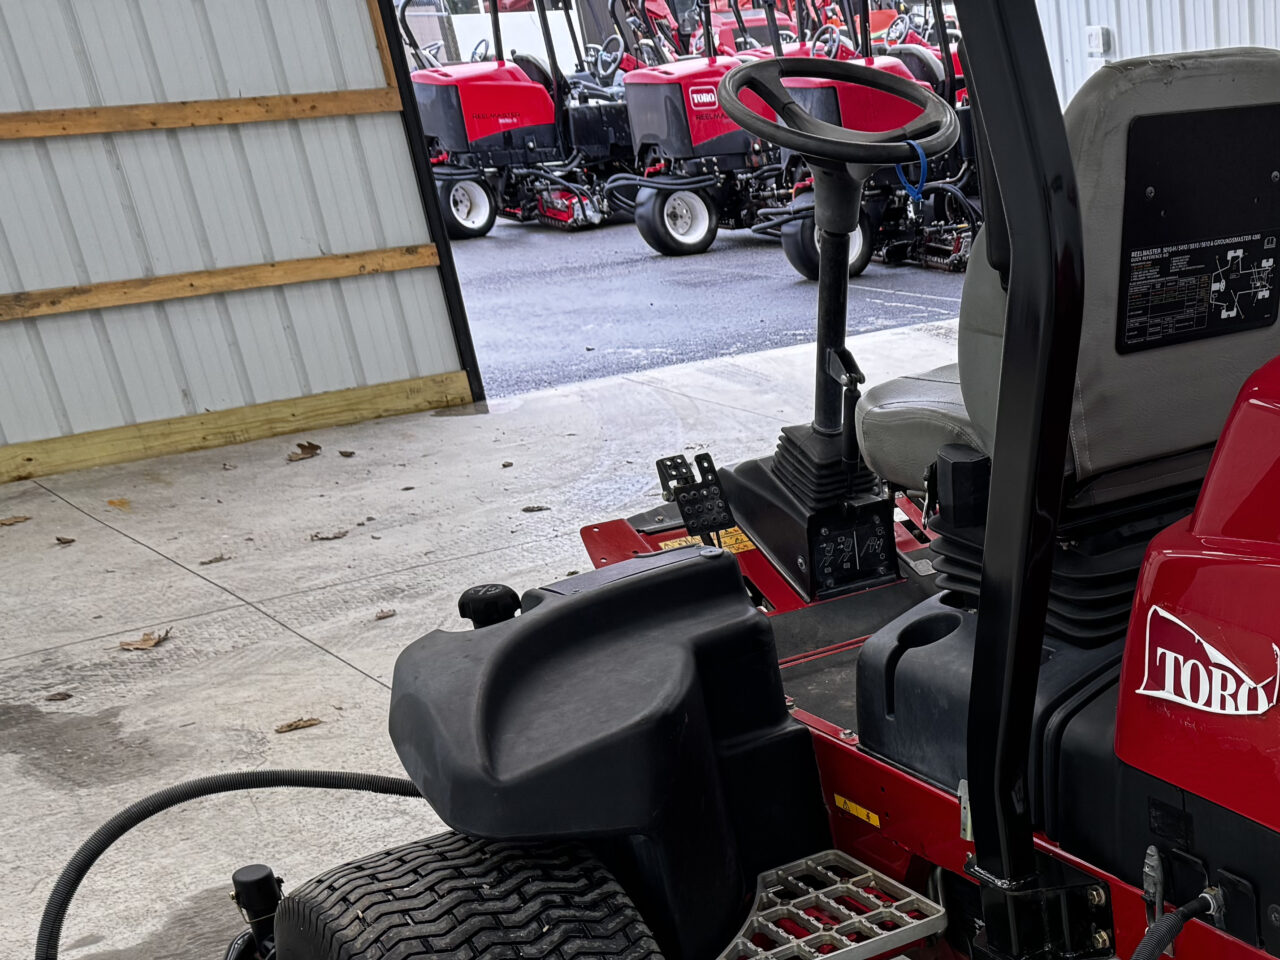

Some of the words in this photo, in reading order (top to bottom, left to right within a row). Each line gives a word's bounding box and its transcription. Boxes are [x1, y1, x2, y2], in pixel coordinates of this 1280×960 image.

[692, 92, 715, 104] TORO
[1131, 248, 1161, 258] REELMASTER
[1157, 646, 1269, 713] TORO
